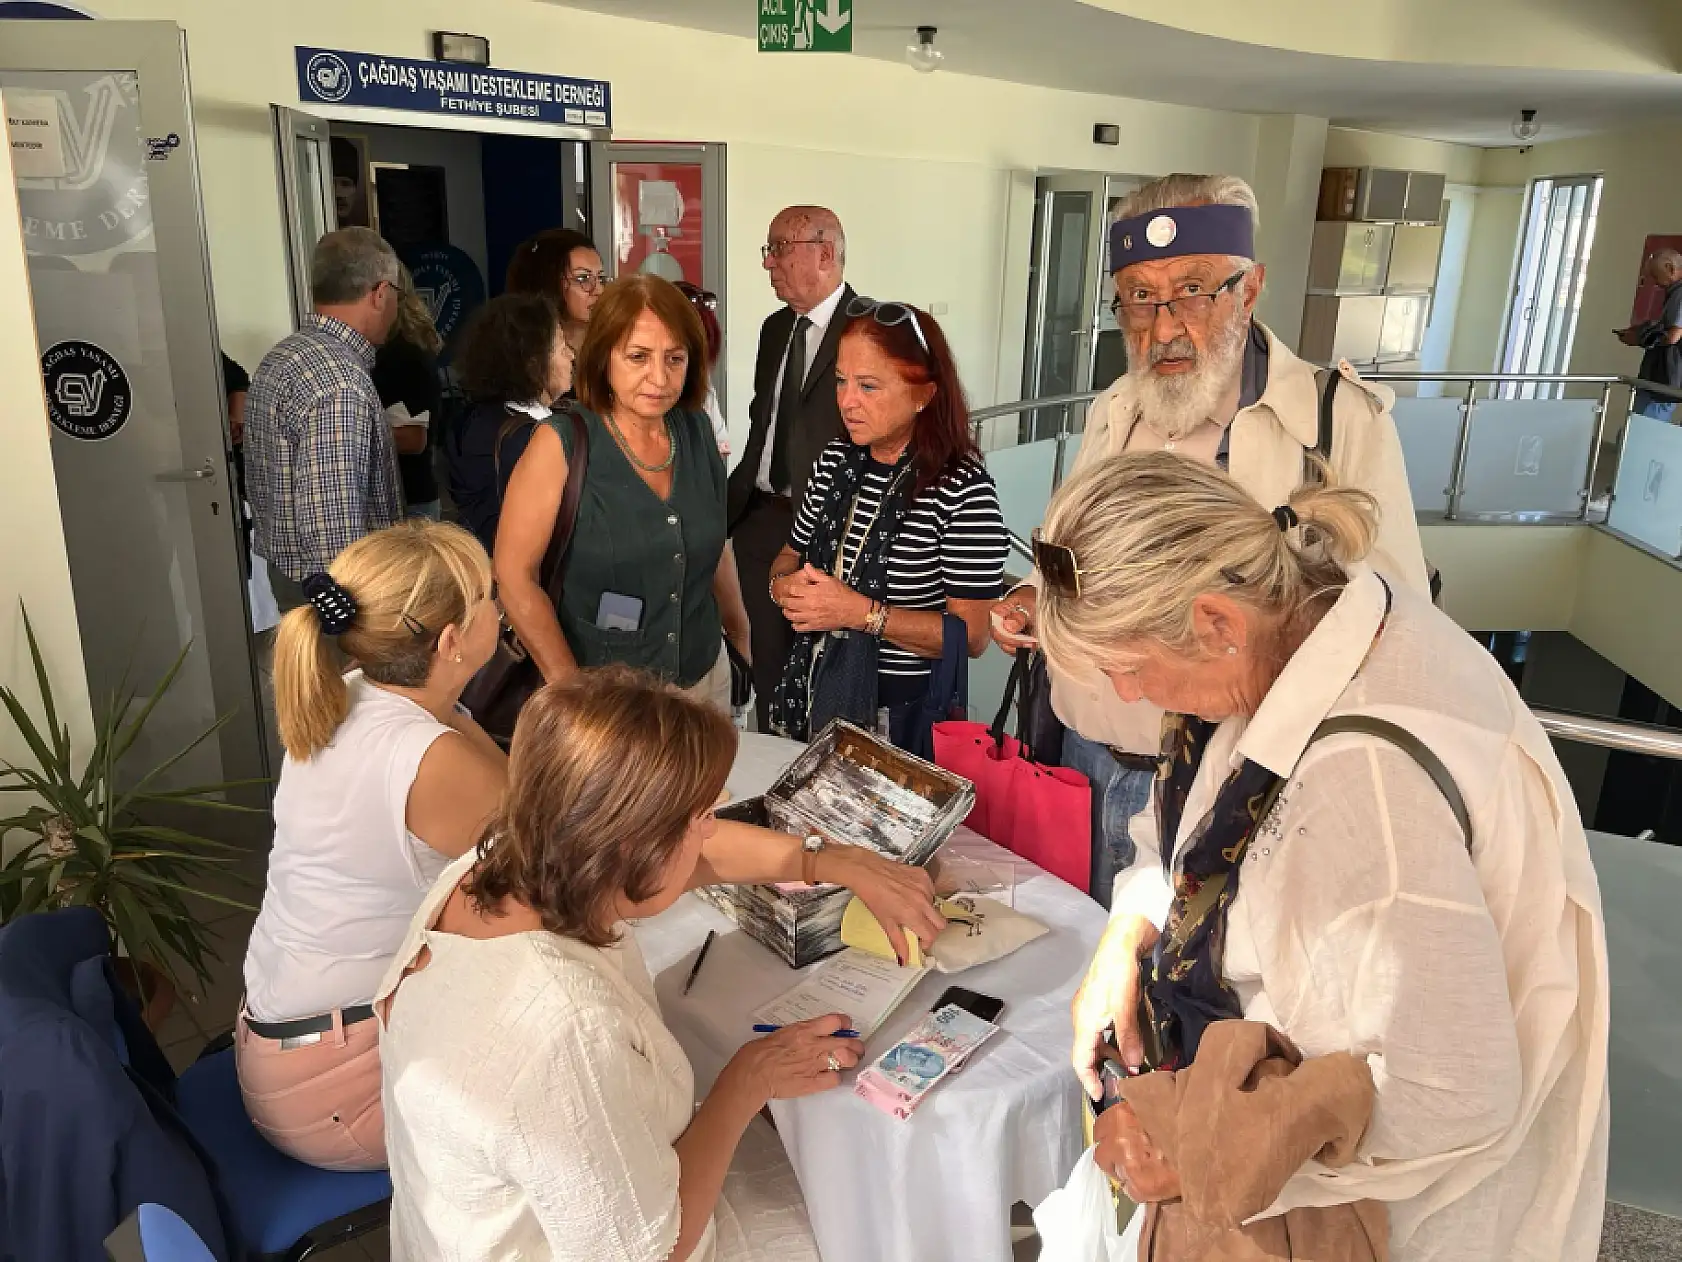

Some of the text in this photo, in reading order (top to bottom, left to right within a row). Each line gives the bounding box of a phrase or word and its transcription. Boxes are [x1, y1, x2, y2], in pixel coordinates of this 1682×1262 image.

[760, 23, 788, 49] ÇIKIŞ
[358, 59, 417, 93] ÇAĞDAŞ
[419, 68, 470, 97] YAŞAMI
[471, 73, 553, 102] DESTEKLEME
[554, 83, 605, 107] DERNEĞİ
[441, 97, 540, 117] FETHİYE ŞUBESİ
